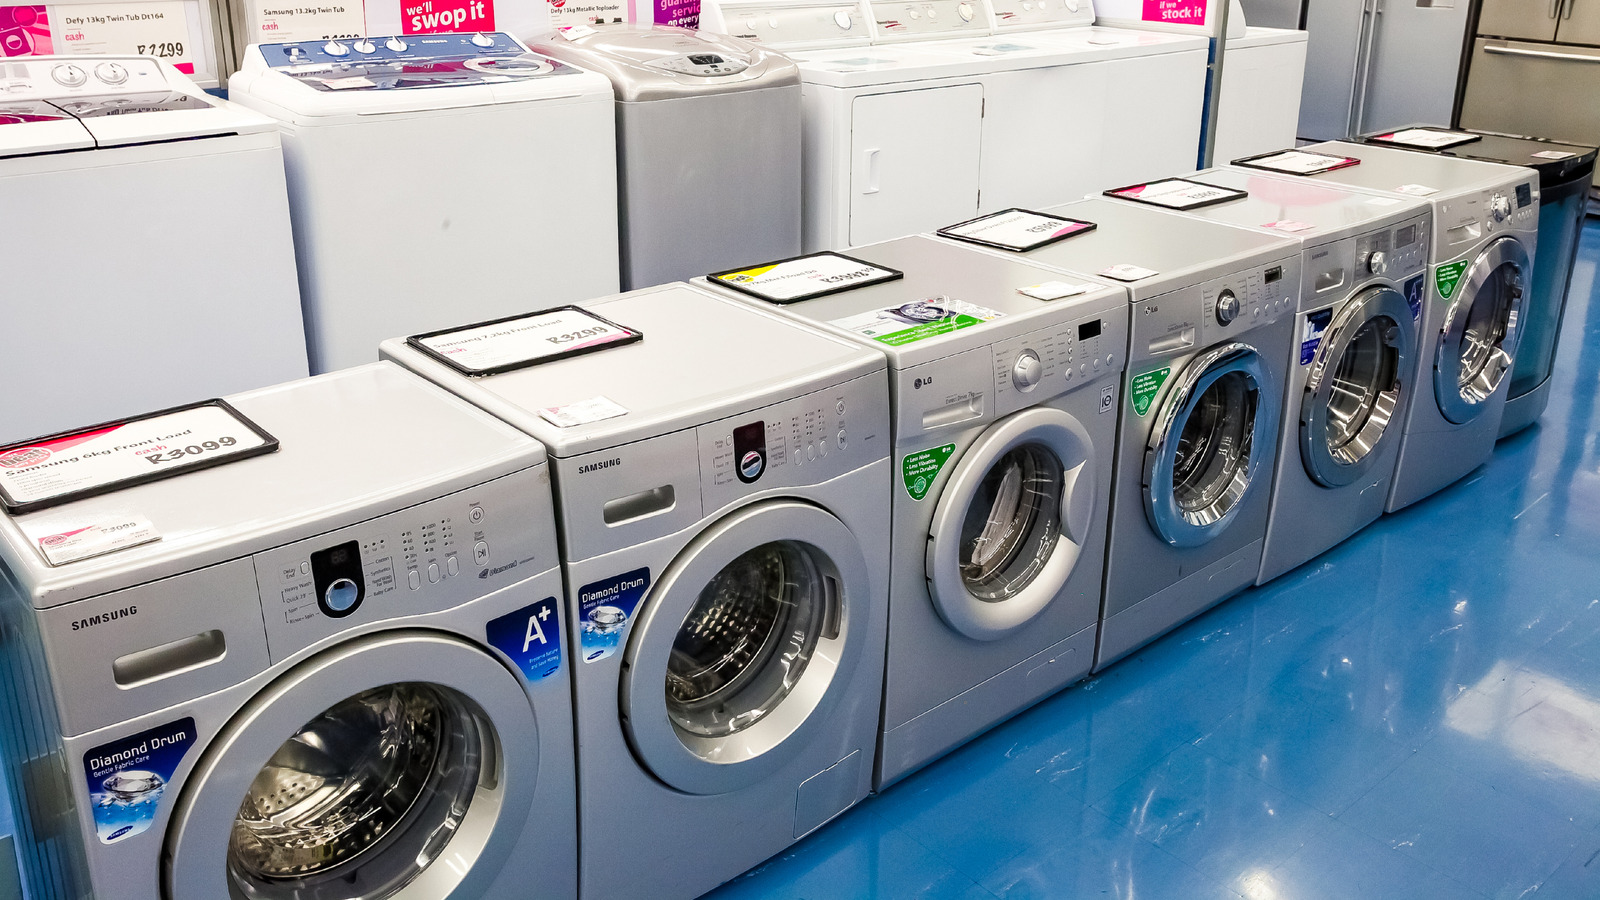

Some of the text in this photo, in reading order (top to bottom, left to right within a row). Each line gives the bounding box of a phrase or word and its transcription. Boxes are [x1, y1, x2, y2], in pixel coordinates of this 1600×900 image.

[295, 7, 317, 15] 13.2kg
[406, 1, 433, 15] we'll
[1160, 1, 1165, 9] if
[66, 12, 164, 25] Defy 13kg Twin Tub Dt164
[411, 0, 485, 31] swop it
[679, 14, 698, 25] every
[1162, 6, 1202, 19] stock it
[262, 22, 278, 31] cash
[65, 31, 85, 41] cash
[545, 326, 609, 344] R3299
[923, 376, 932, 385] LG
[6, 429, 192, 477] Samsung 6kg Front Load
[134, 444, 167, 456] cash
[145, 436, 237, 465] R3099
[578, 457, 621, 474] SAMSUNG
[581, 577, 644, 603] Diamond Drum
[71, 605, 138, 631] SAMSUNG
[90, 731, 186, 771] Diamond Drum
[93, 755, 150, 778] Gentle Fabric Care
